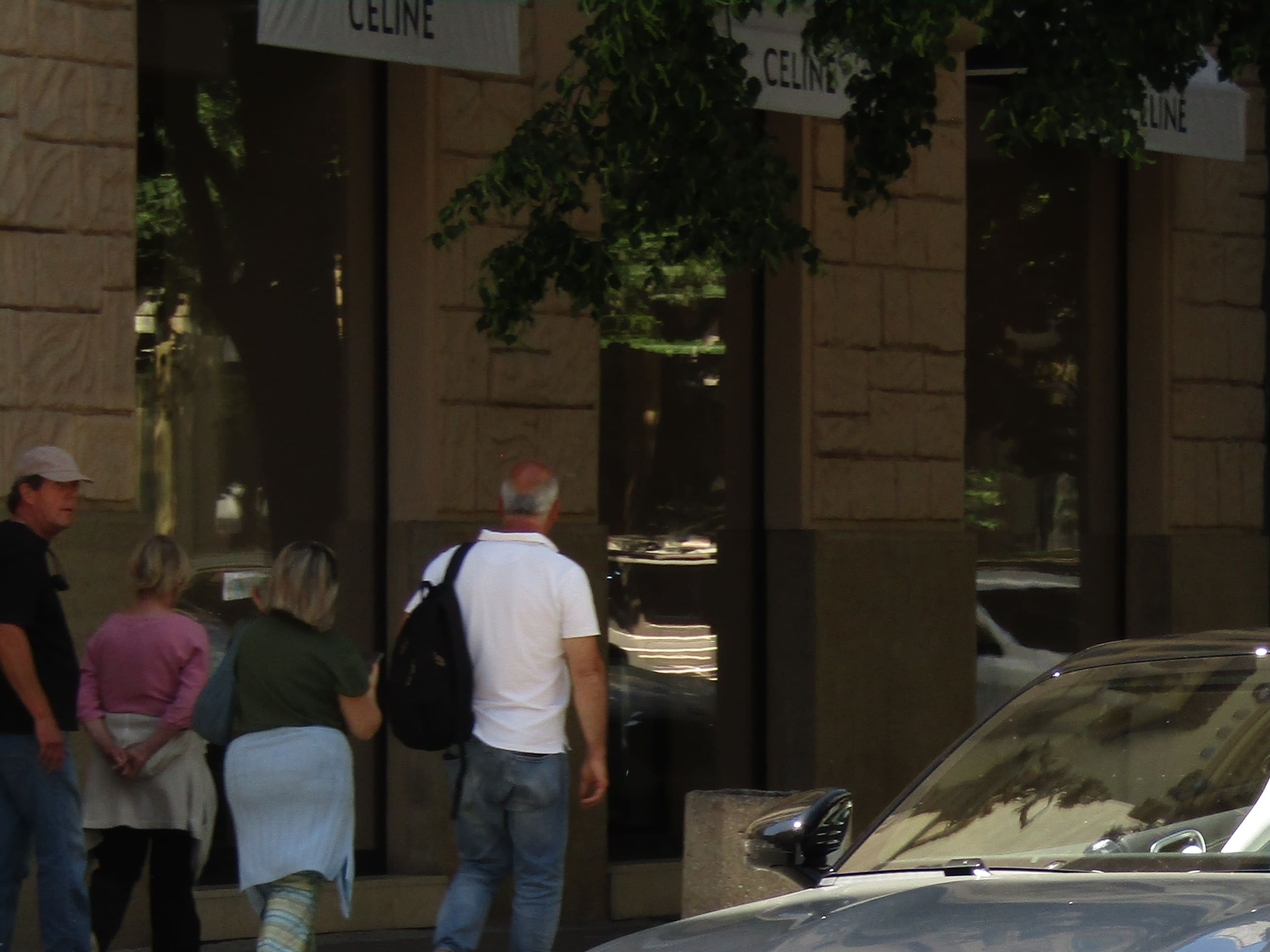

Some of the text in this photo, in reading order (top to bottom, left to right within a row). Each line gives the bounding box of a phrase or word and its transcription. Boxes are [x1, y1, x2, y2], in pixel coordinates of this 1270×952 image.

[349, 0, 434, 39] CELINE
[764, 47, 836, 94] CELINE
[1140, 93, 1187, 133] LINE
